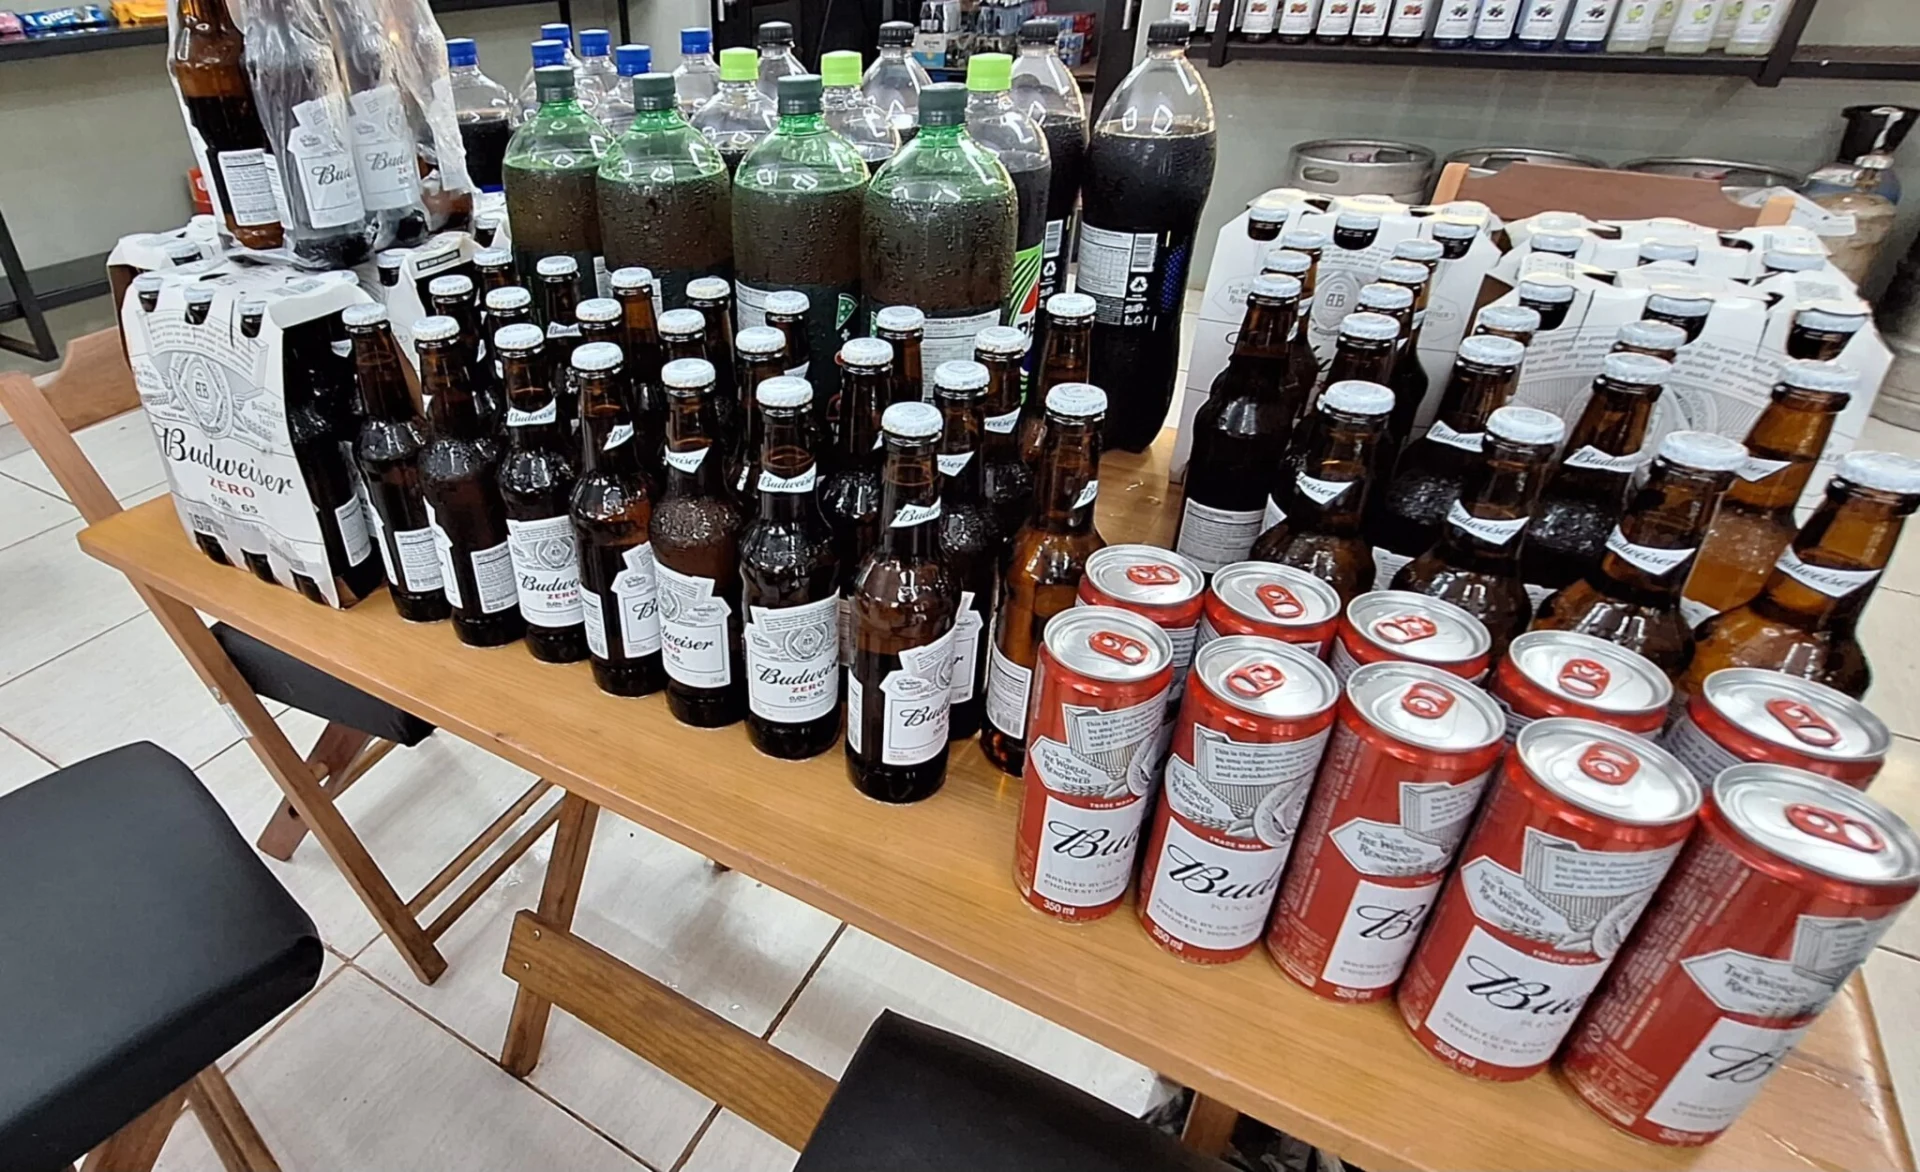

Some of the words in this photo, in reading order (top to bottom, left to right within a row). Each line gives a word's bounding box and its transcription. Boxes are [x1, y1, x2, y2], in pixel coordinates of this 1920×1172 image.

[152, 422, 294, 494] Budweiser
[208, 475, 255, 498] ZERO
[1610, 533, 1678, 566] udweiser
[1780, 554, 1861, 589] udweiser
[547, 589, 579, 600] ZERO
[791, 680, 825, 693] ZERO
[1355, 830, 1378, 847] THE
[1043, 899, 1061, 913] 350
[1062, 907, 1075, 916] ml
[1152, 925, 1170, 943] 350
[1170, 939, 1184, 951] ml
[1724, 963, 1752, 982] THE
[1433, 1040, 1457, 1060] 350
[1457, 1054, 1477, 1069] ml
